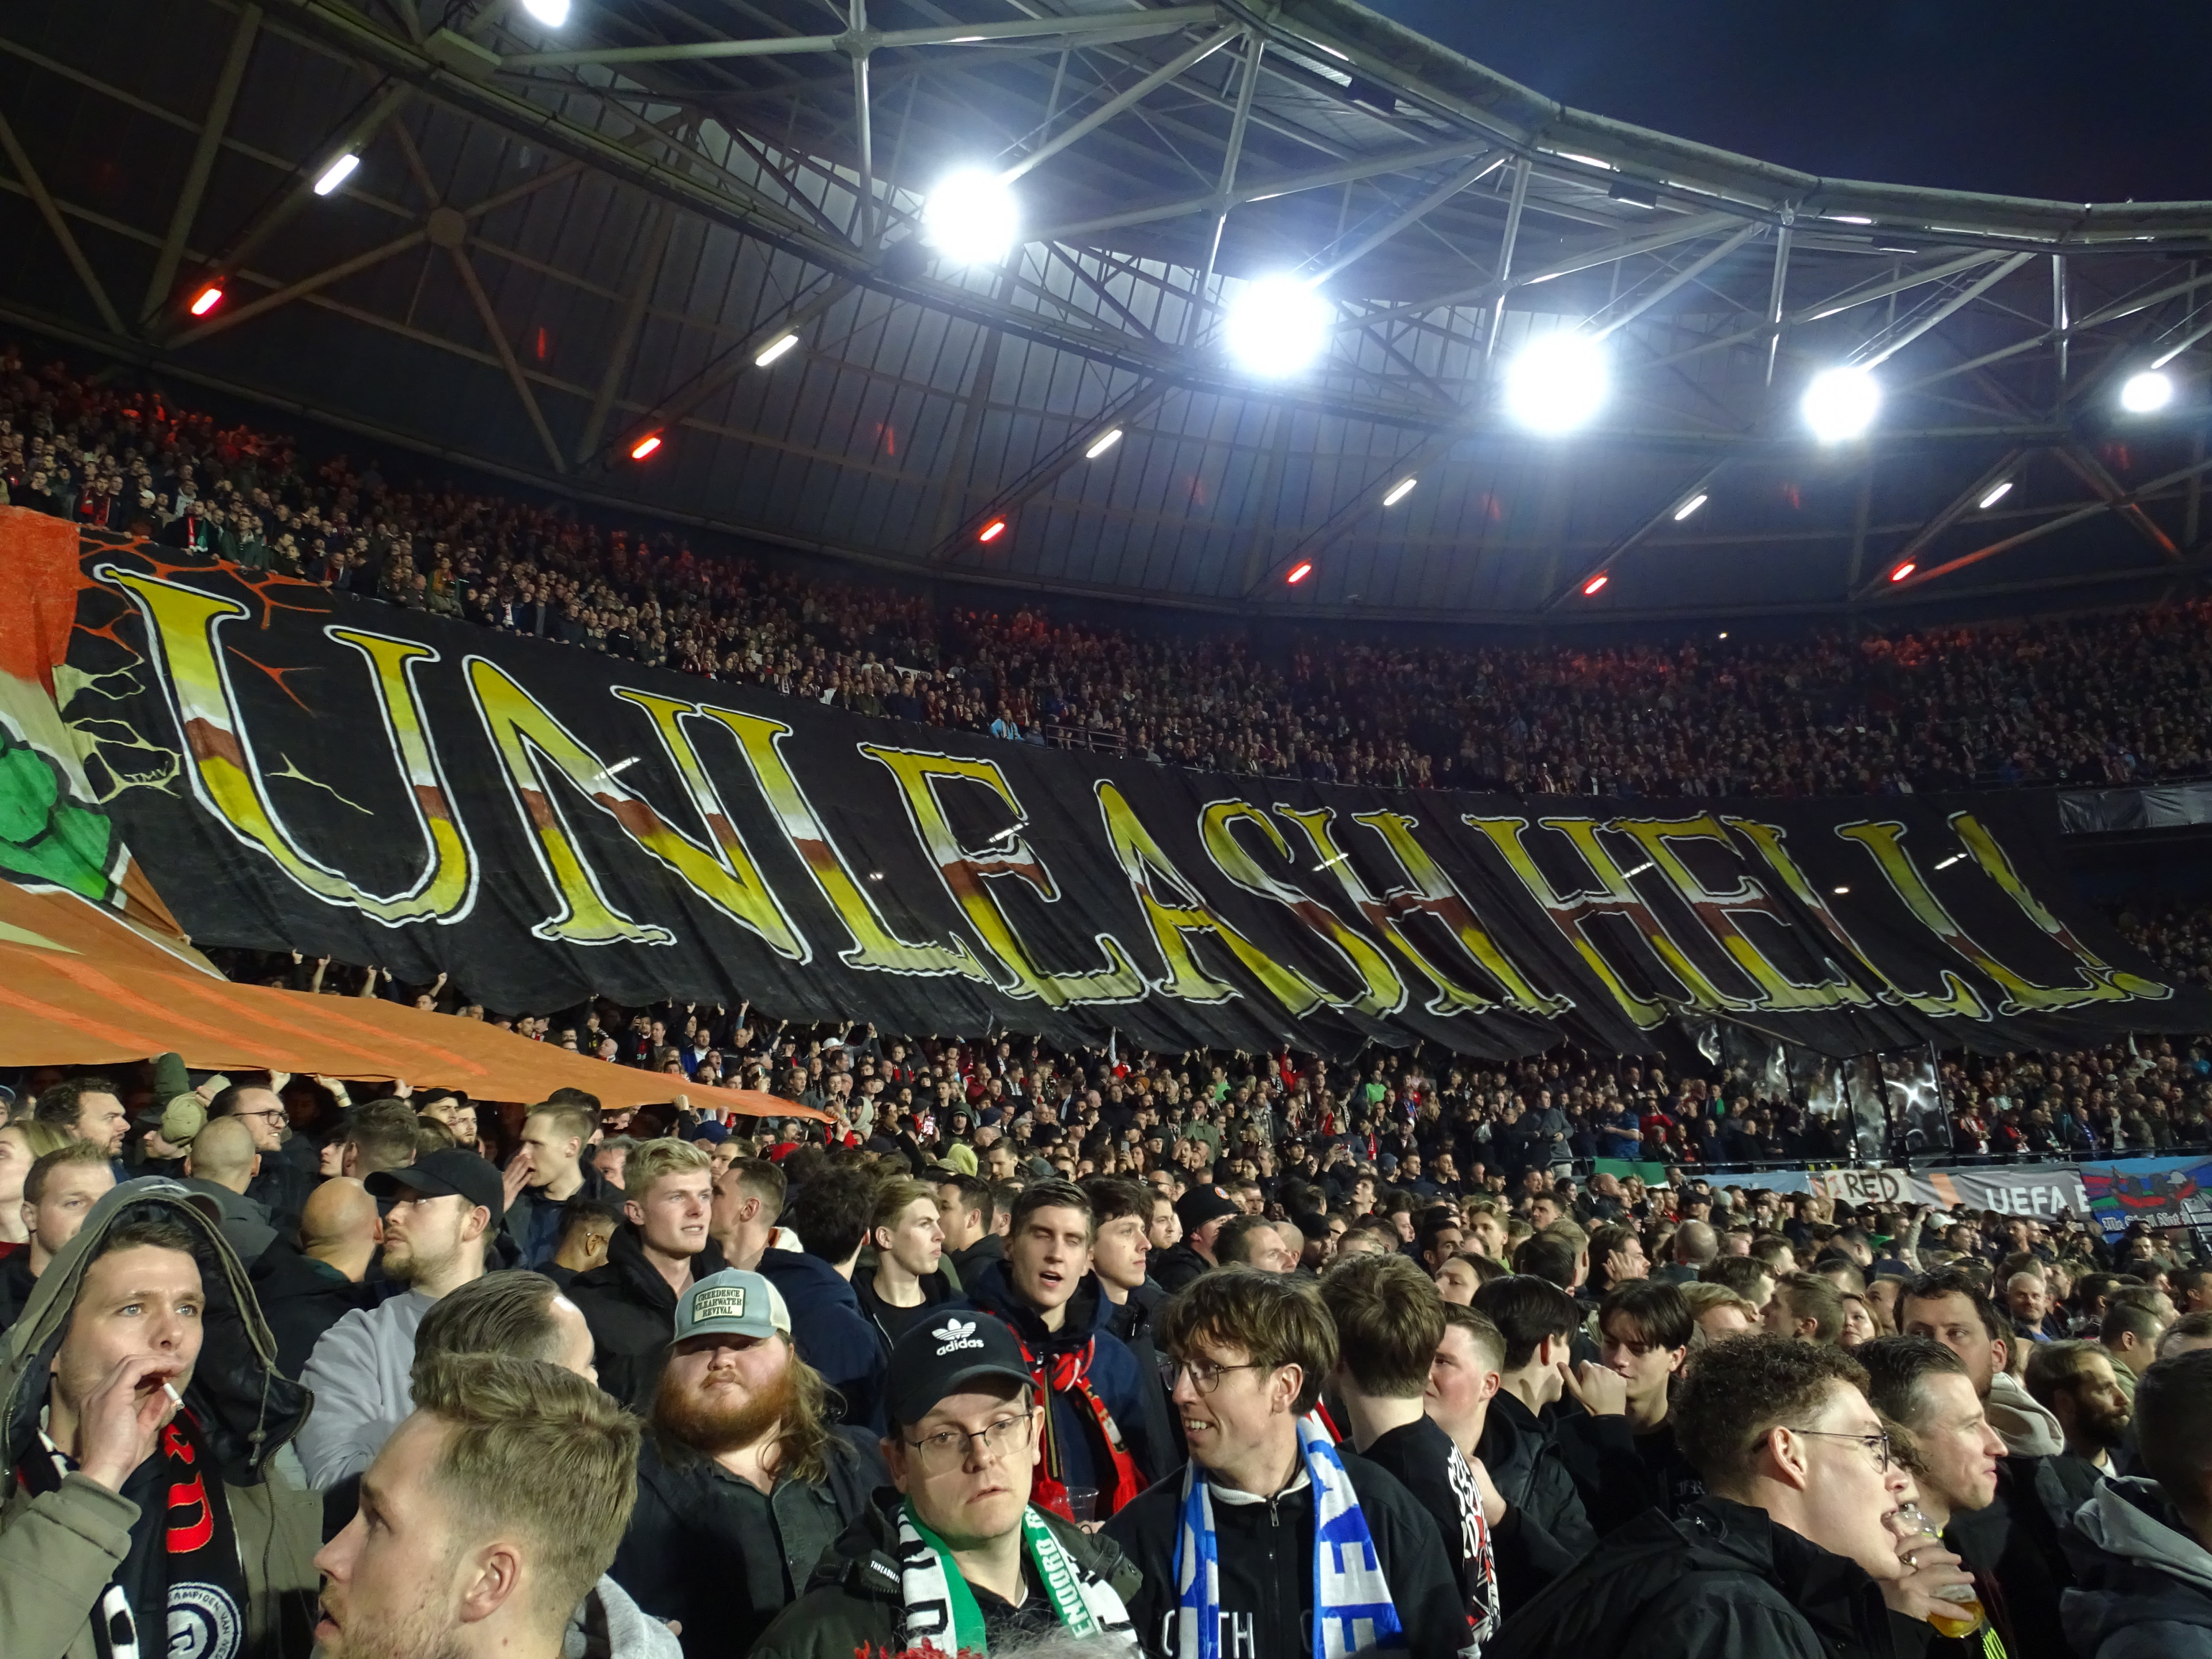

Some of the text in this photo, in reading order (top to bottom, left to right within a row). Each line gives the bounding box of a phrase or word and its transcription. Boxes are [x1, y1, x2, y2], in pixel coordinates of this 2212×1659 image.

[93, 562, 1576, 1020] UNLEASH
[1843, 1172, 1900, 1201] RED
[1985, 1185, 2068, 1215] UEFA
[695, 1297, 743, 1311] CLEARWATER
[698, 1289, 740, 1302] CREEDENCE
[703, 1306, 733, 1317] REVIVAL
[935, 1338, 984, 1356] adidas
[221, 1612, 230, 1635] VAN
